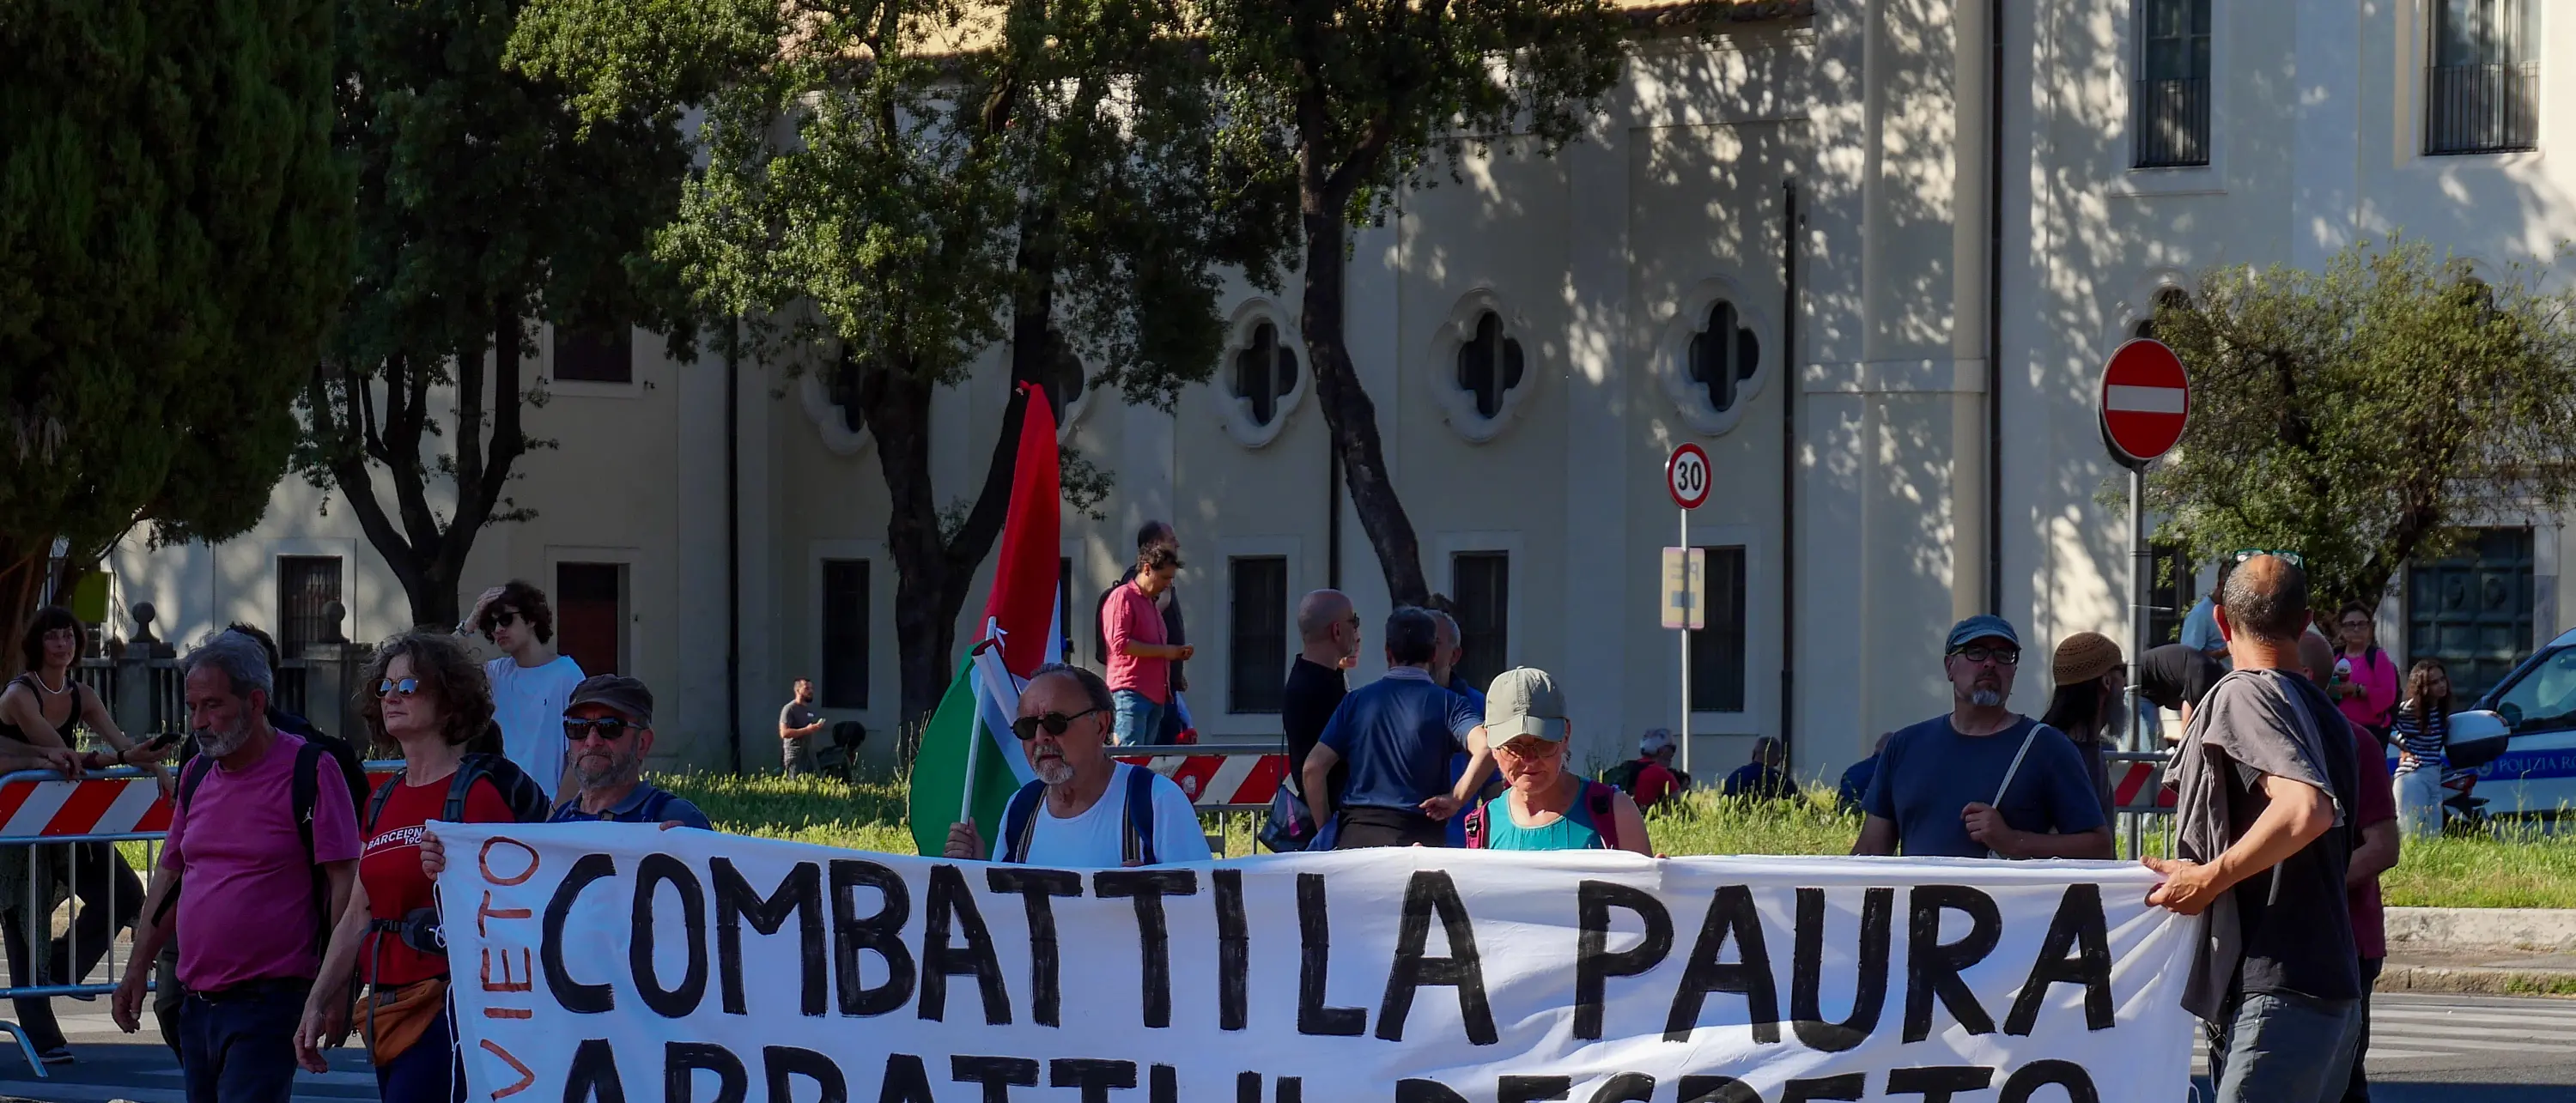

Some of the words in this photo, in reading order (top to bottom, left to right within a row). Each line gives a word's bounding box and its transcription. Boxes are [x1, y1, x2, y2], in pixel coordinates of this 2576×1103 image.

[1678, 461, 1702, 491] 30
[2499, 757, 2556, 772] POLIZIA
[540, 852, 1249, 1031] COMBATTI
[1297, 869, 1498, 1045] LA
[1572, 879, 2116, 1052] PAURA
